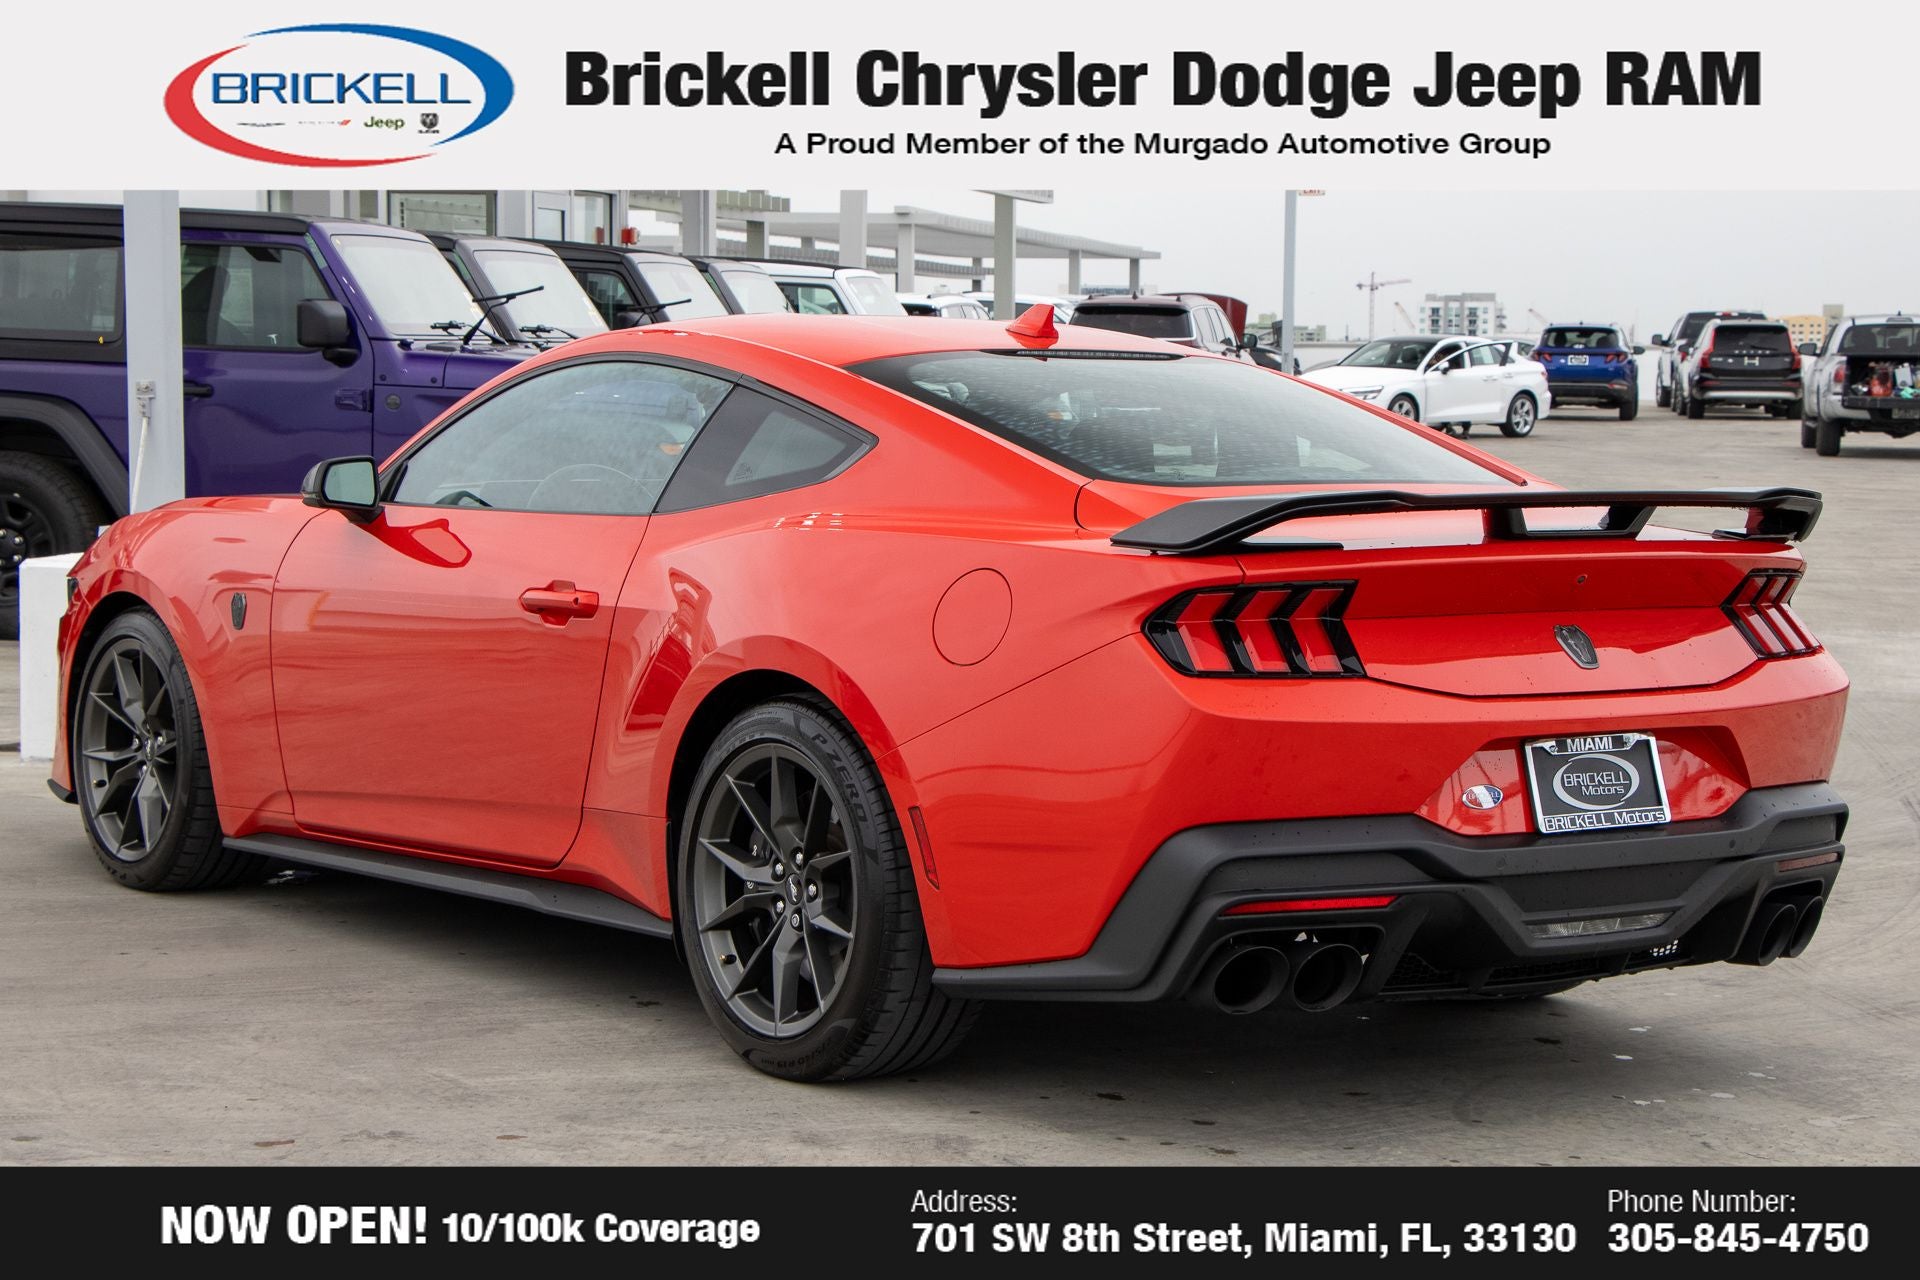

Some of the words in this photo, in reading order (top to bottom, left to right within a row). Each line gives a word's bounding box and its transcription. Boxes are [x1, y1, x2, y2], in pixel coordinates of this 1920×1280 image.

[1566, 736, 1613, 752] MIAMI
[1563, 770, 1630, 788] BRICKELL
[1581, 784, 1625, 796] Motors
[1544, 813, 1611, 832] BRICKELL
[1615, 809, 1666, 825] Motors
